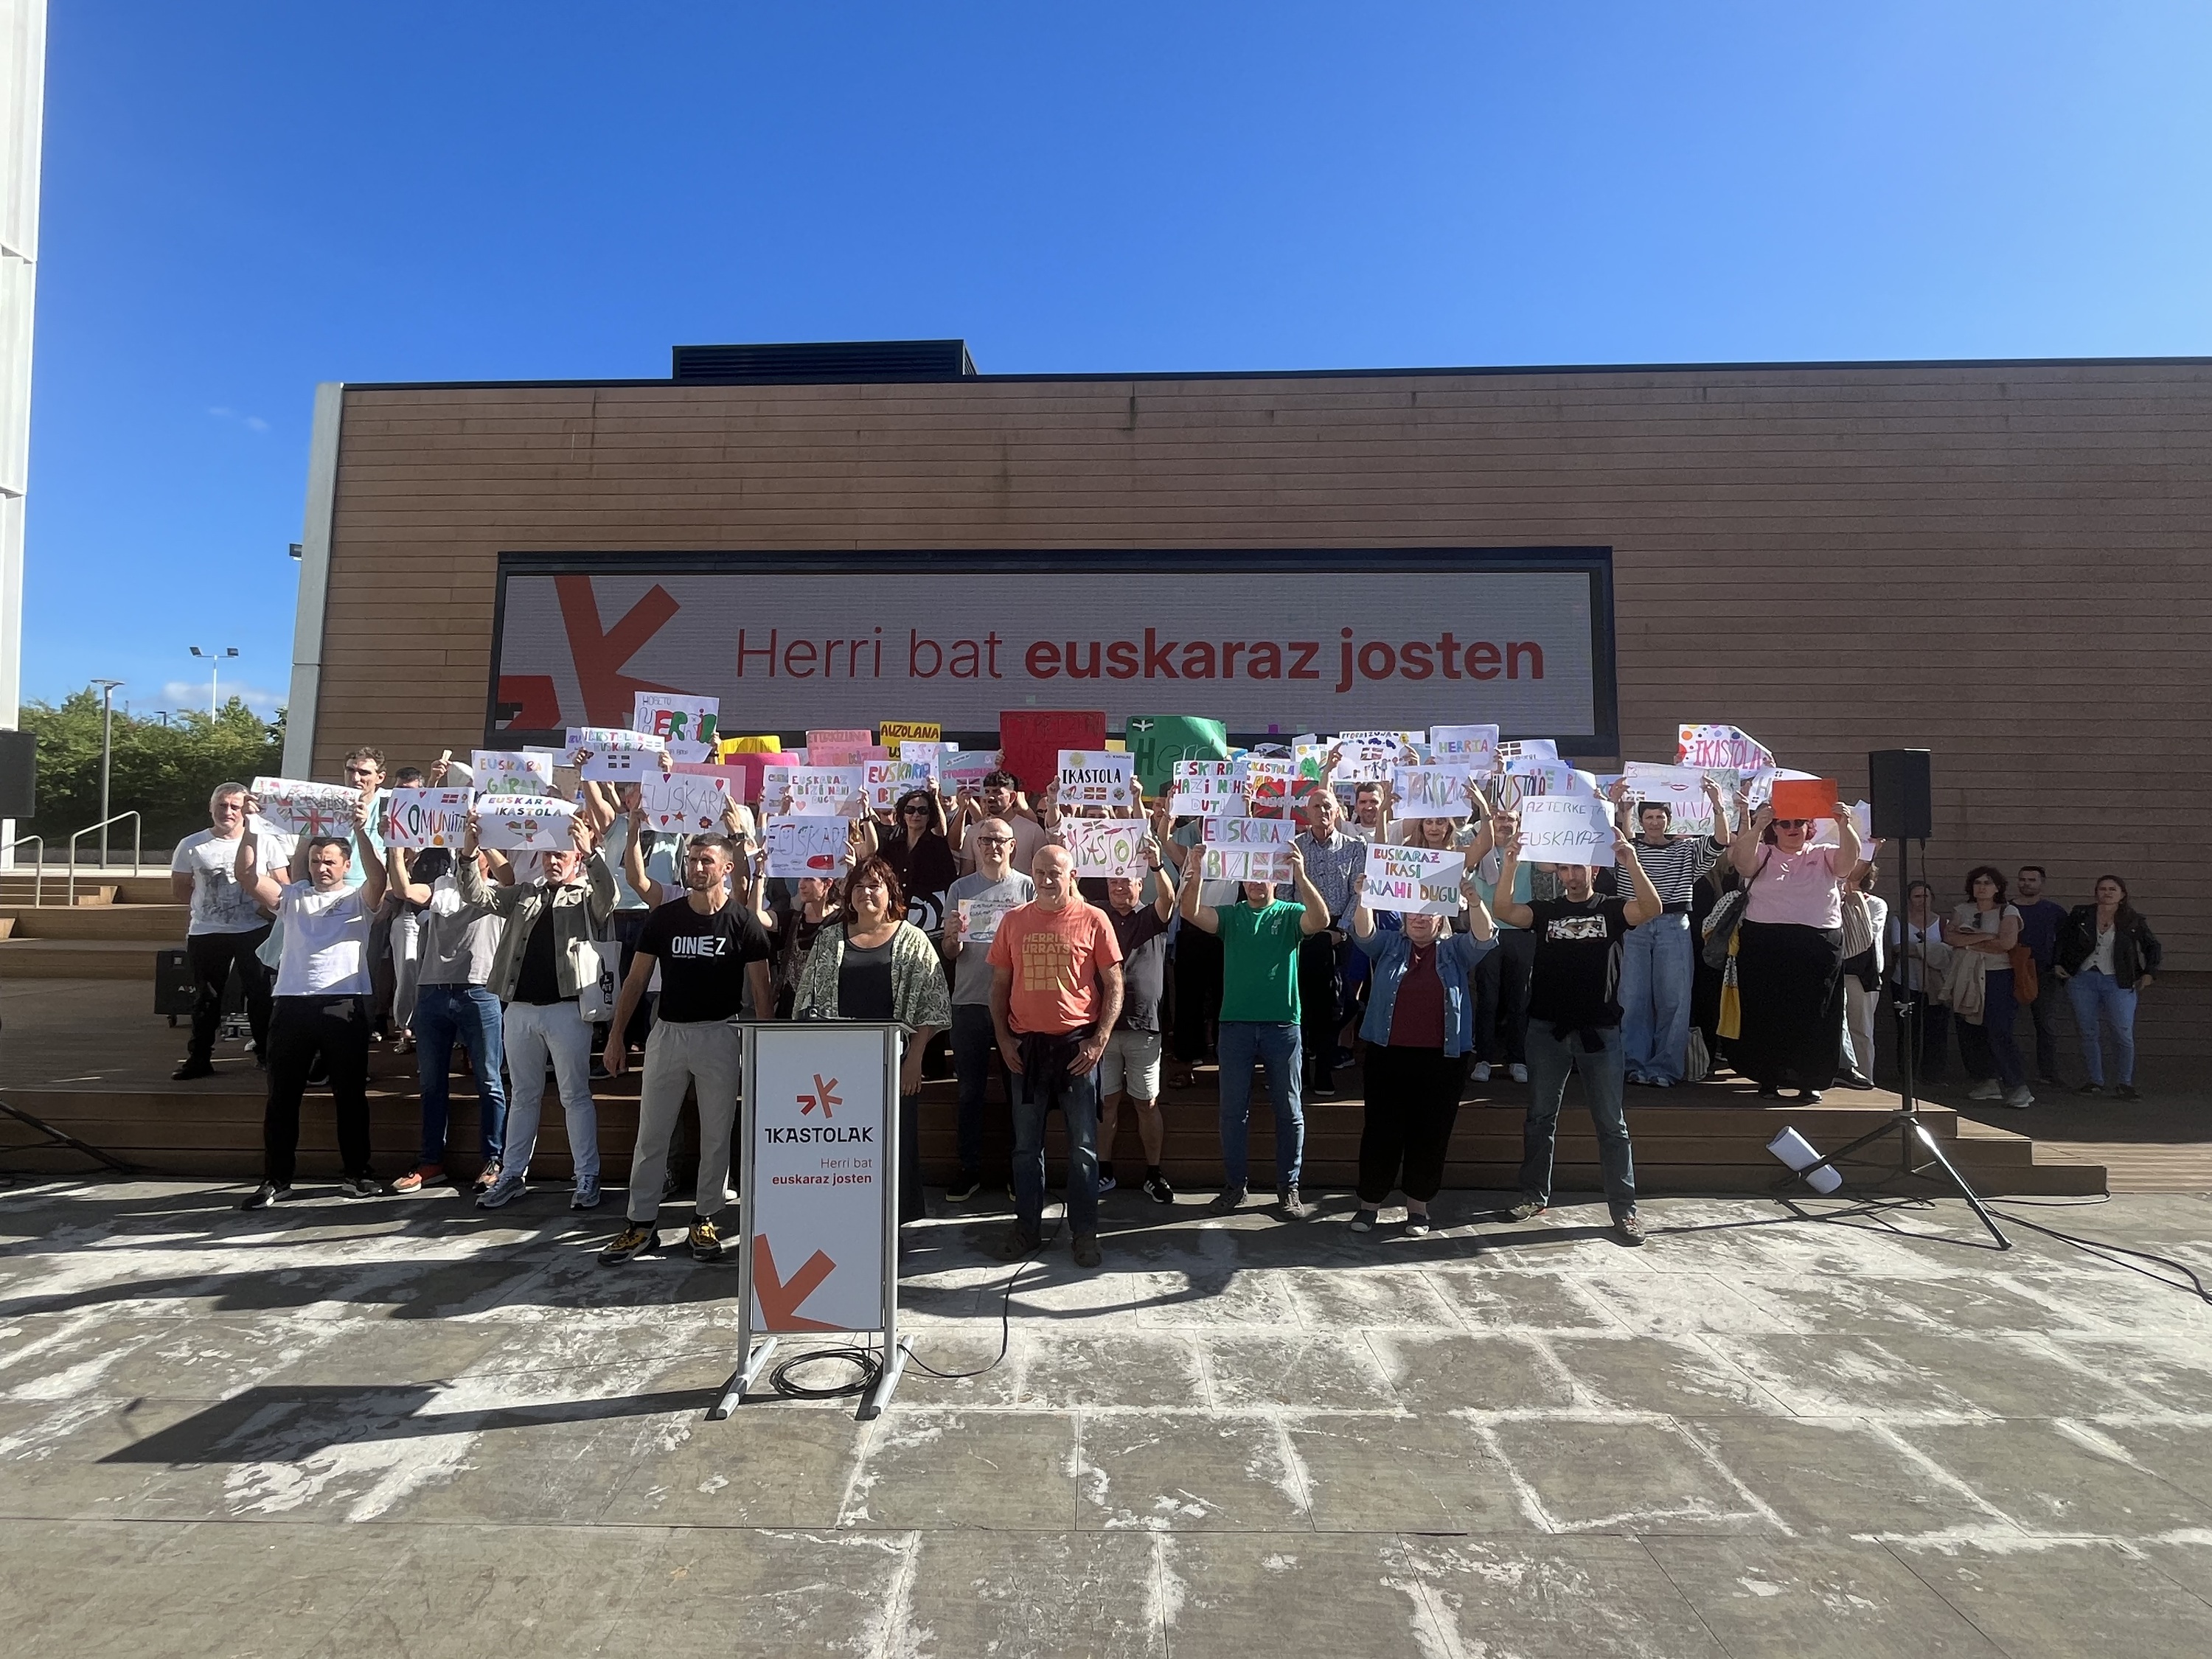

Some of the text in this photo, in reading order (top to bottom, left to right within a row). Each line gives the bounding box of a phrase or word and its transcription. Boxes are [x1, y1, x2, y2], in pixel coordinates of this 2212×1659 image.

[738, 627, 1544, 693] Herri bat euskaraz josten
[1439, 740, 1489, 753] HERRIA
[1695, 740, 1762, 769] IKASTOLA
[1175, 761, 1248, 776] EUSKARAZ
[1062, 768, 1121, 785] IKASTOLA
[488, 796, 553, 805] EUSKARA
[495, 807, 562, 817] IKASTOLA
[1203, 818, 1293, 844] EUSKARAZ
[1374, 848, 1441, 864] EUSKARAZ
[1207, 849, 1250, 880] BIZI
[1420, 884, 1458, 904] DUGU
[1023, 933, 1059, 943] HERRI
[672, 935, 727, 957] OINEZ
[1021, 943, 1071, 955] URRATS
[821, 1158, 872, 1169] Herri bat
[772, 1172, 872, 1186] euskaraz josten
